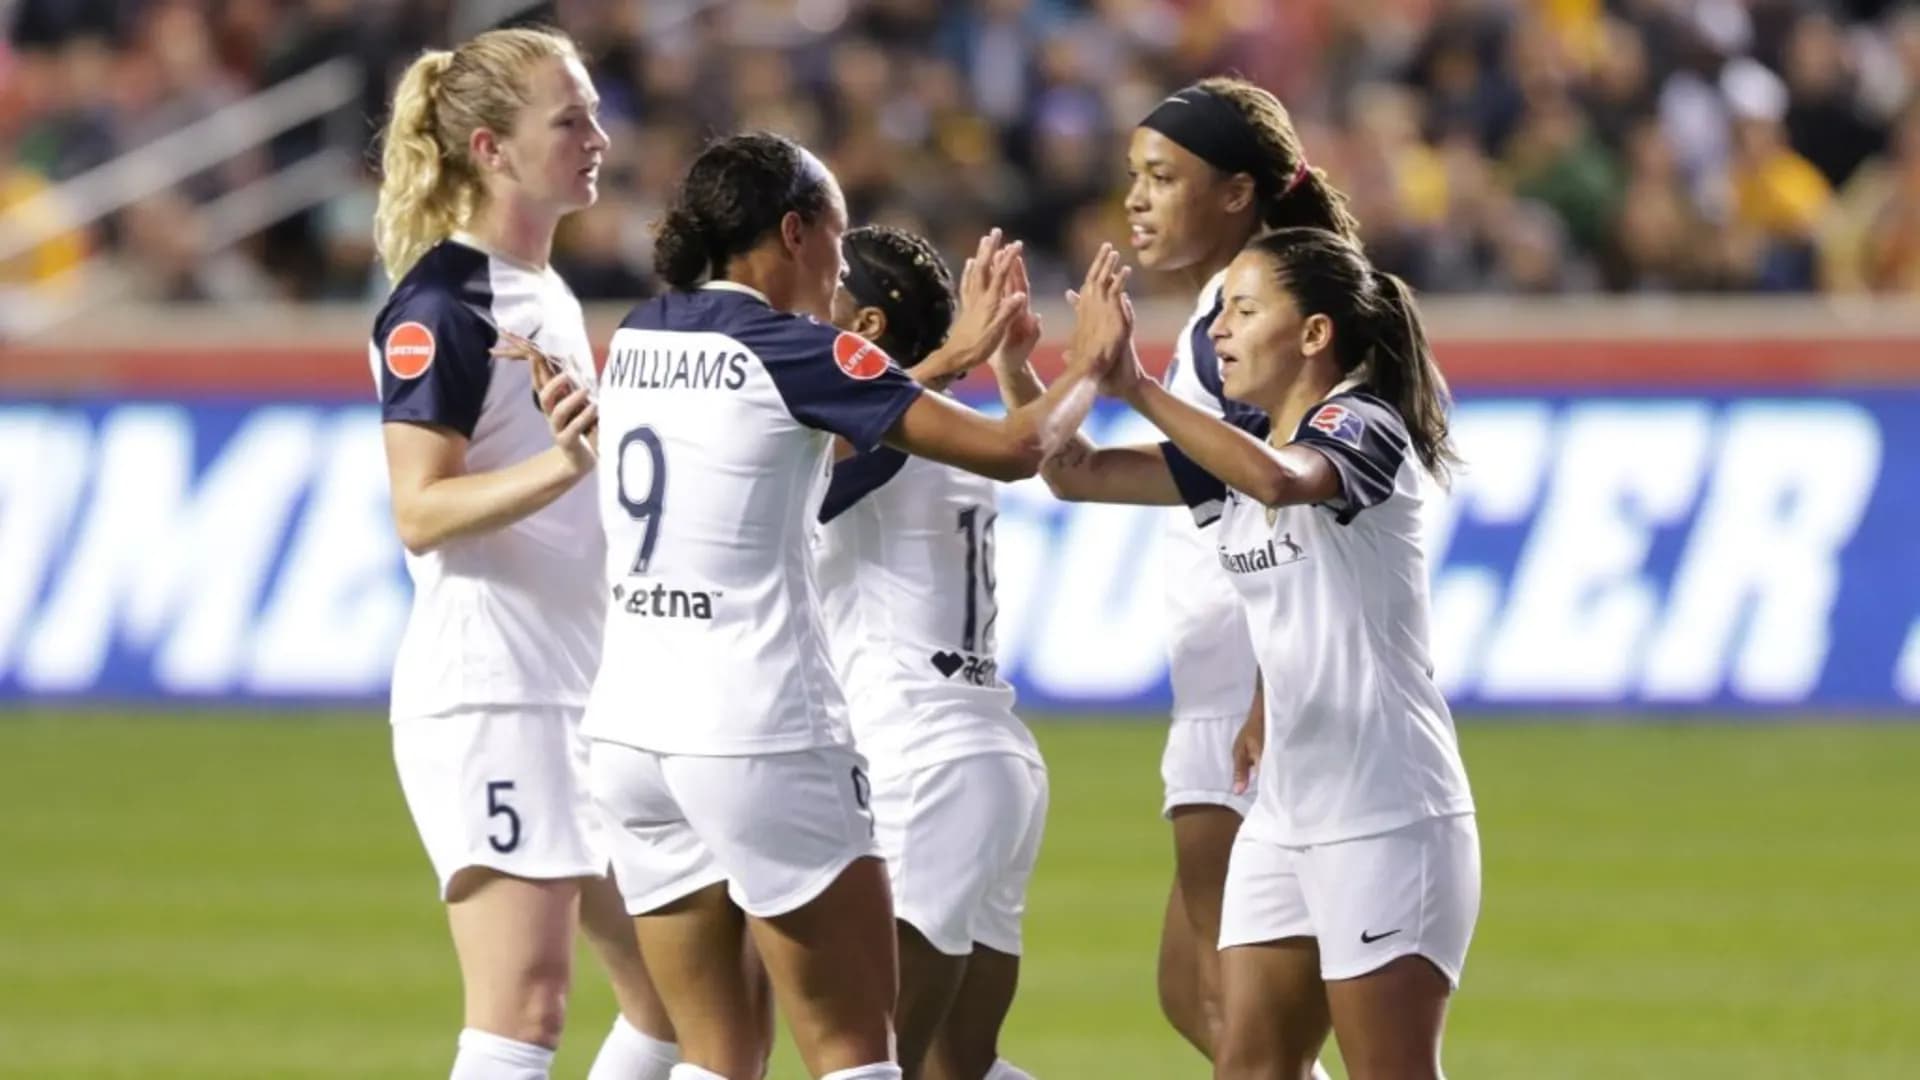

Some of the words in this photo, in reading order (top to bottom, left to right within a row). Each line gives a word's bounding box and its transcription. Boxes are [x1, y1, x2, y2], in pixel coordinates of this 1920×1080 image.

[610, 348, 748, 390] WILLIAMS
[616, 424, 669, 577] 9
[487, 781, 521, 854] 5
